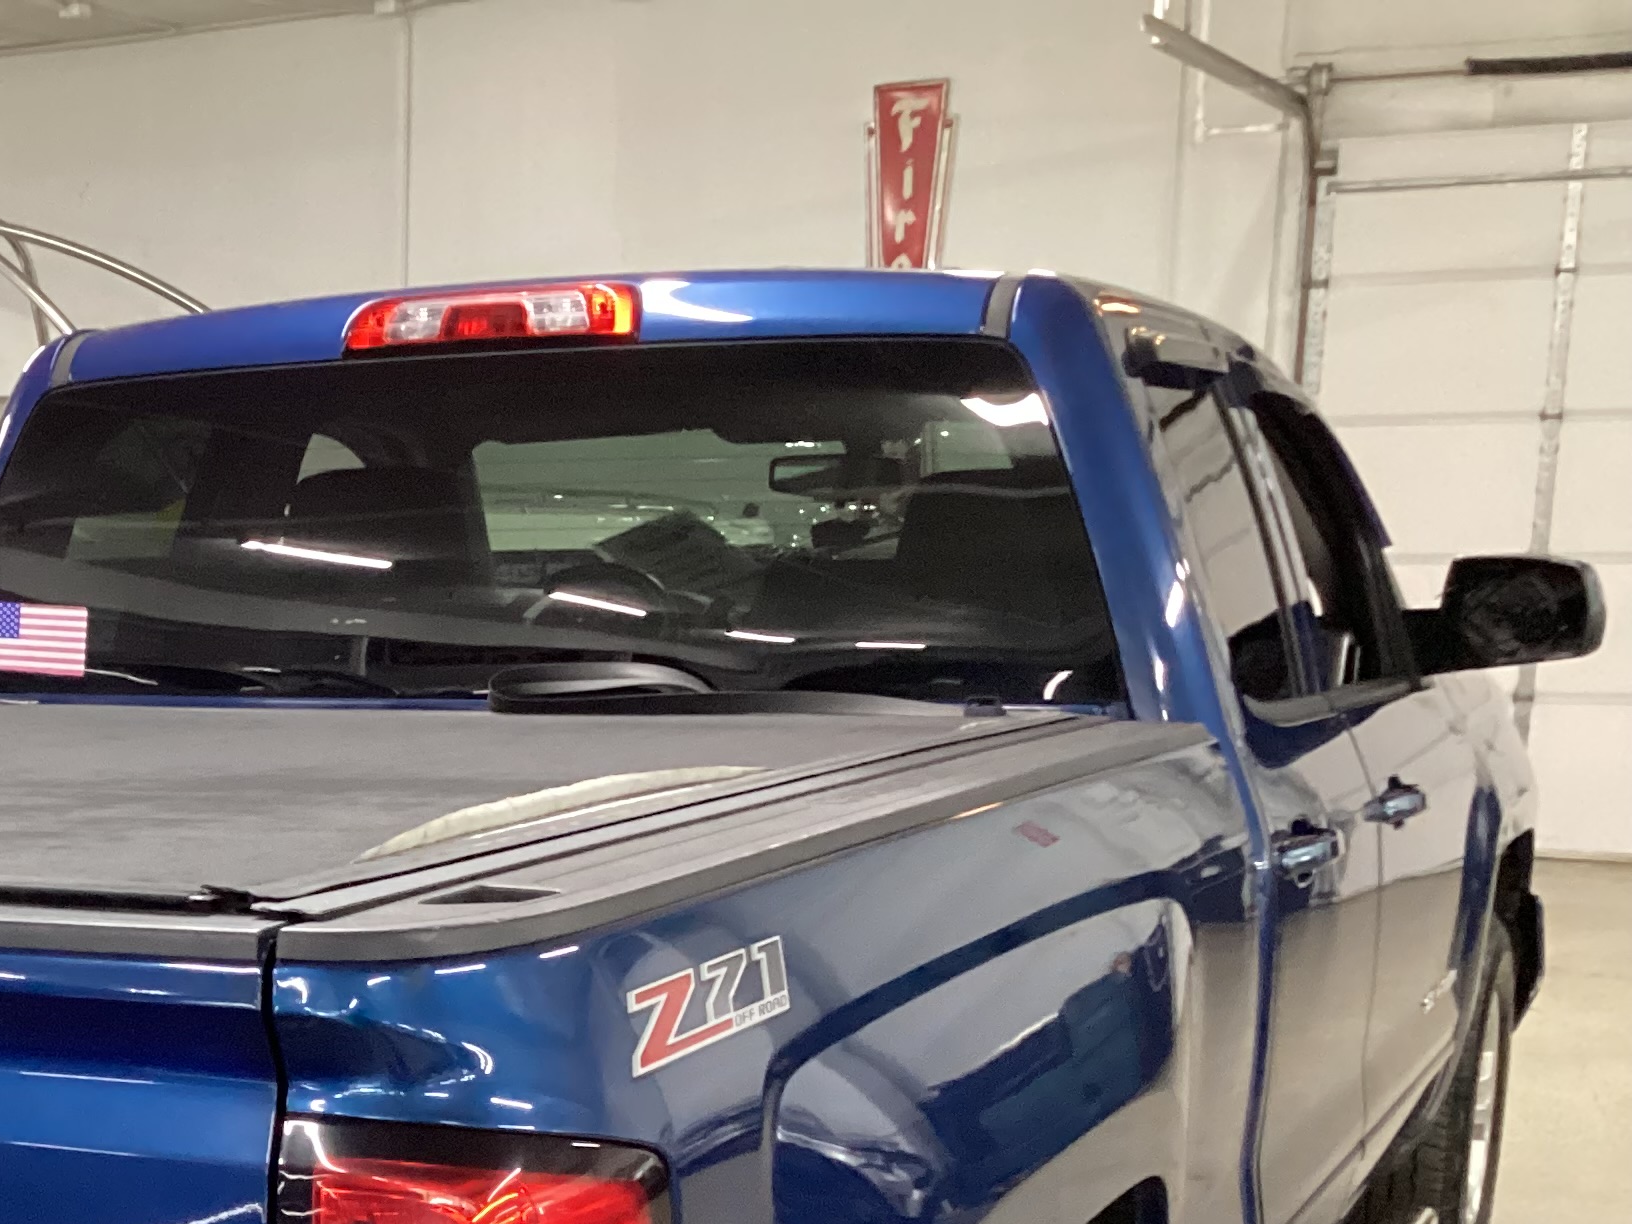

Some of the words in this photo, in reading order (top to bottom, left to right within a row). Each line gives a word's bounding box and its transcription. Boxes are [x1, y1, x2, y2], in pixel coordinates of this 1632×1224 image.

[626, 935, 790, 1078] Z71
[734, 1008, 756, 1027] OFF
[758, 994, 787, 1017] ROAD
